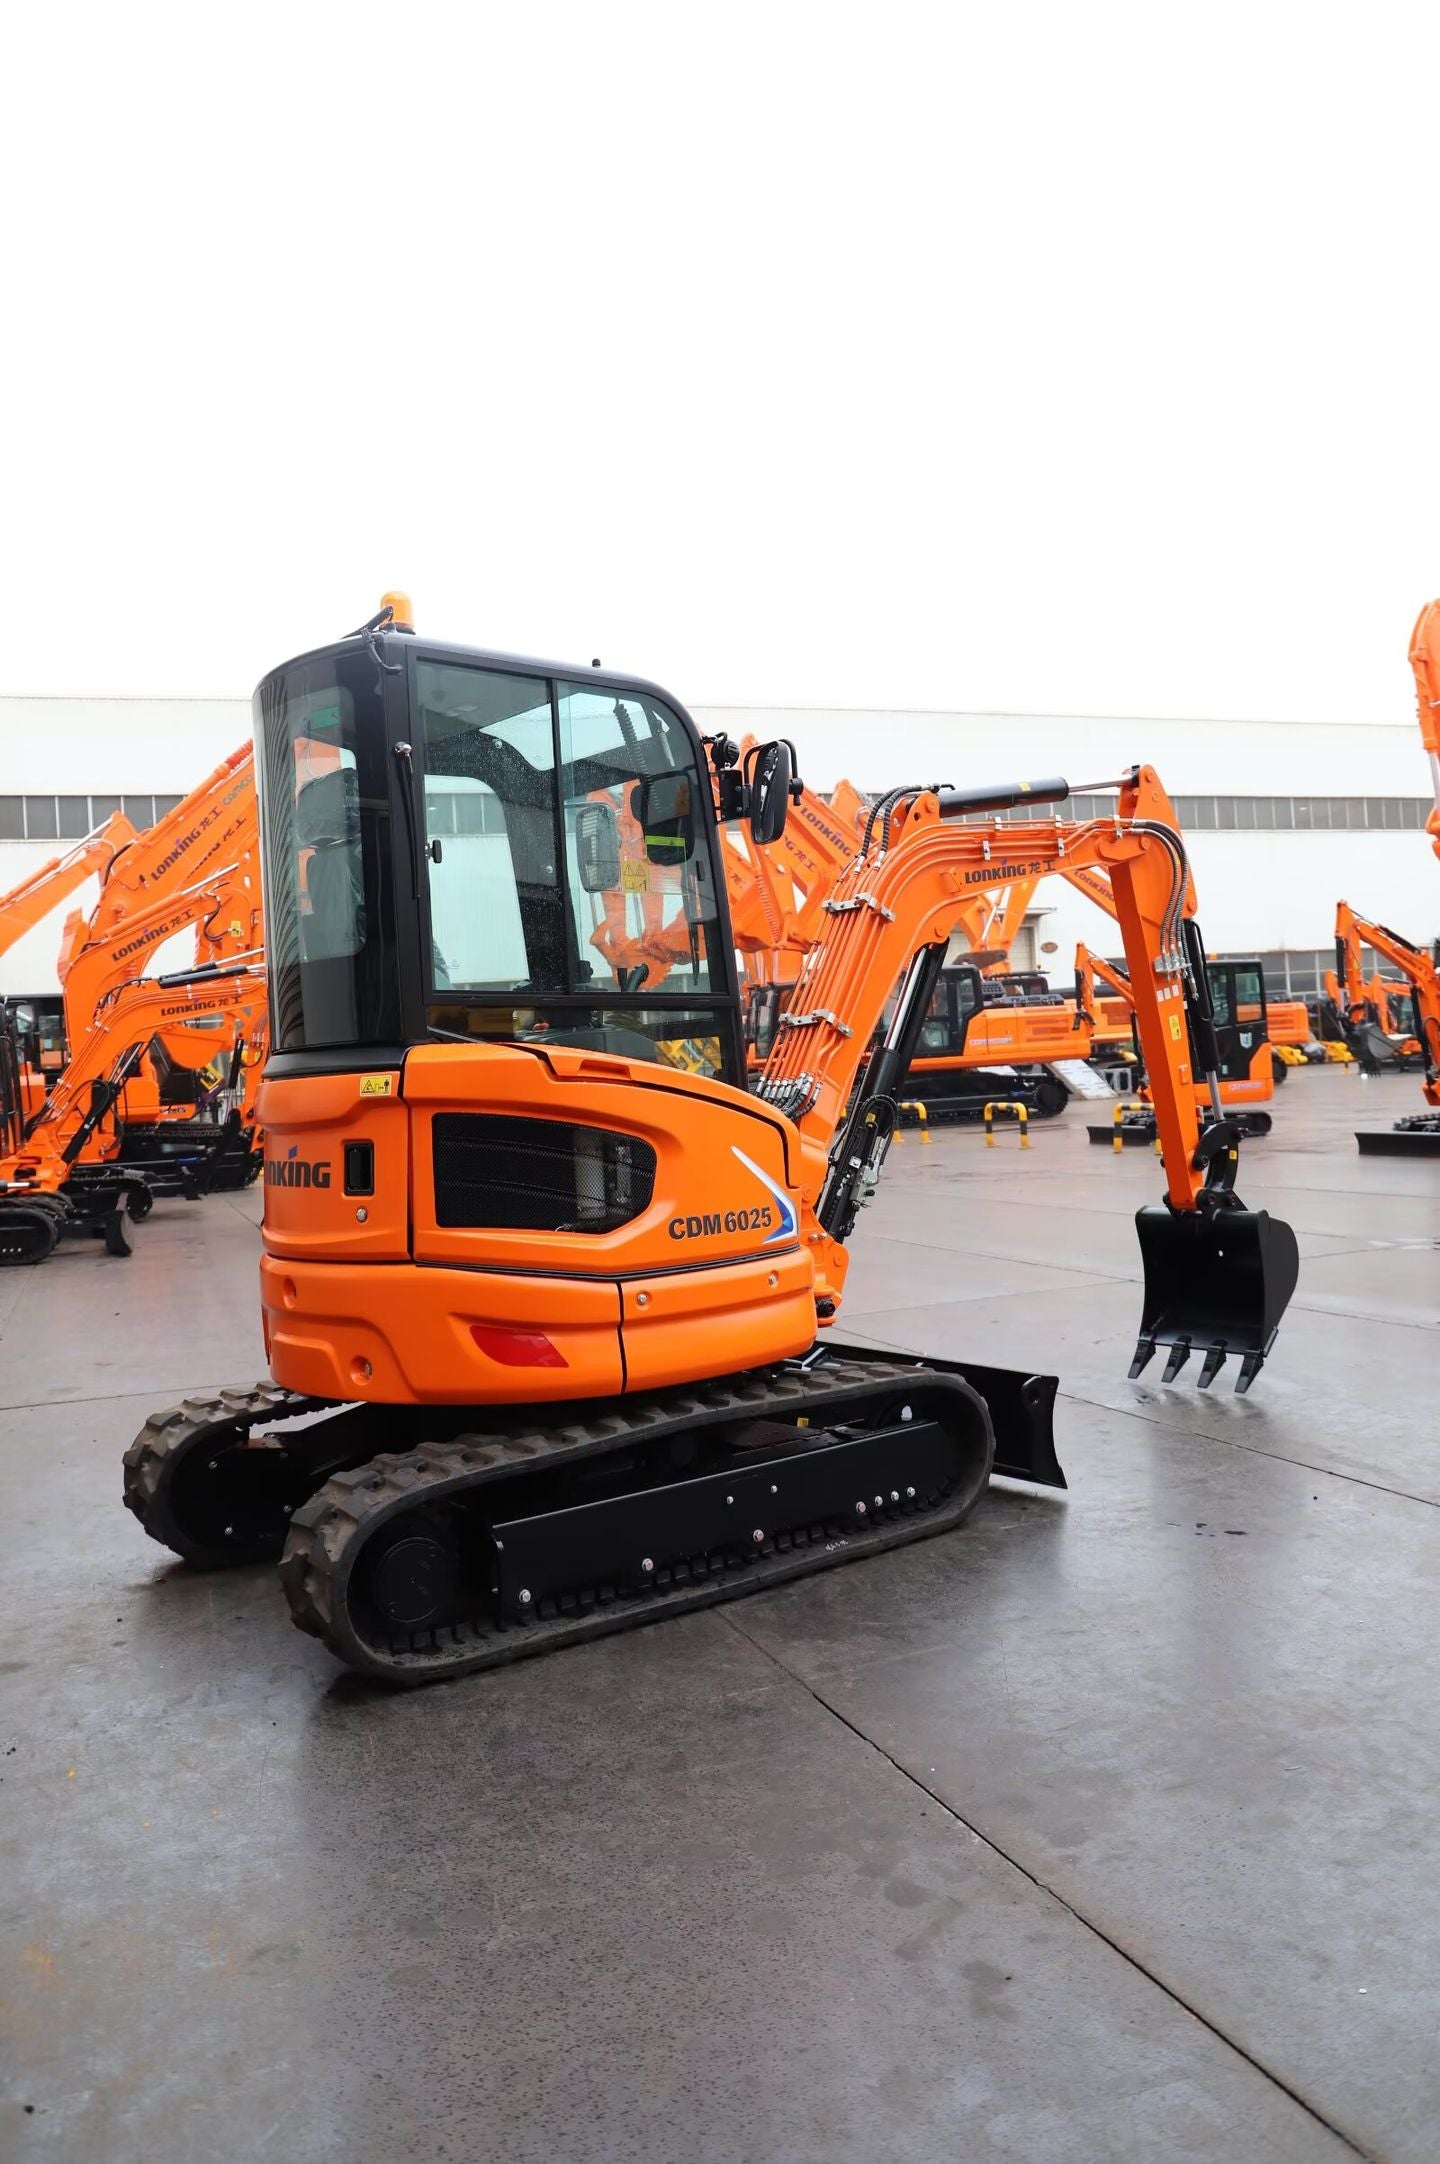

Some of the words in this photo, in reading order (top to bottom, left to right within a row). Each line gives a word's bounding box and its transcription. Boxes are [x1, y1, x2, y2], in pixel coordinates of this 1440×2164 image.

[1028, 859, 1056, 874] 龙工
[264, 1145, 331, 1188] NKING
[669, 1214, 722, 1239] CDM
[725, 1207, 772, 1232] 6025
